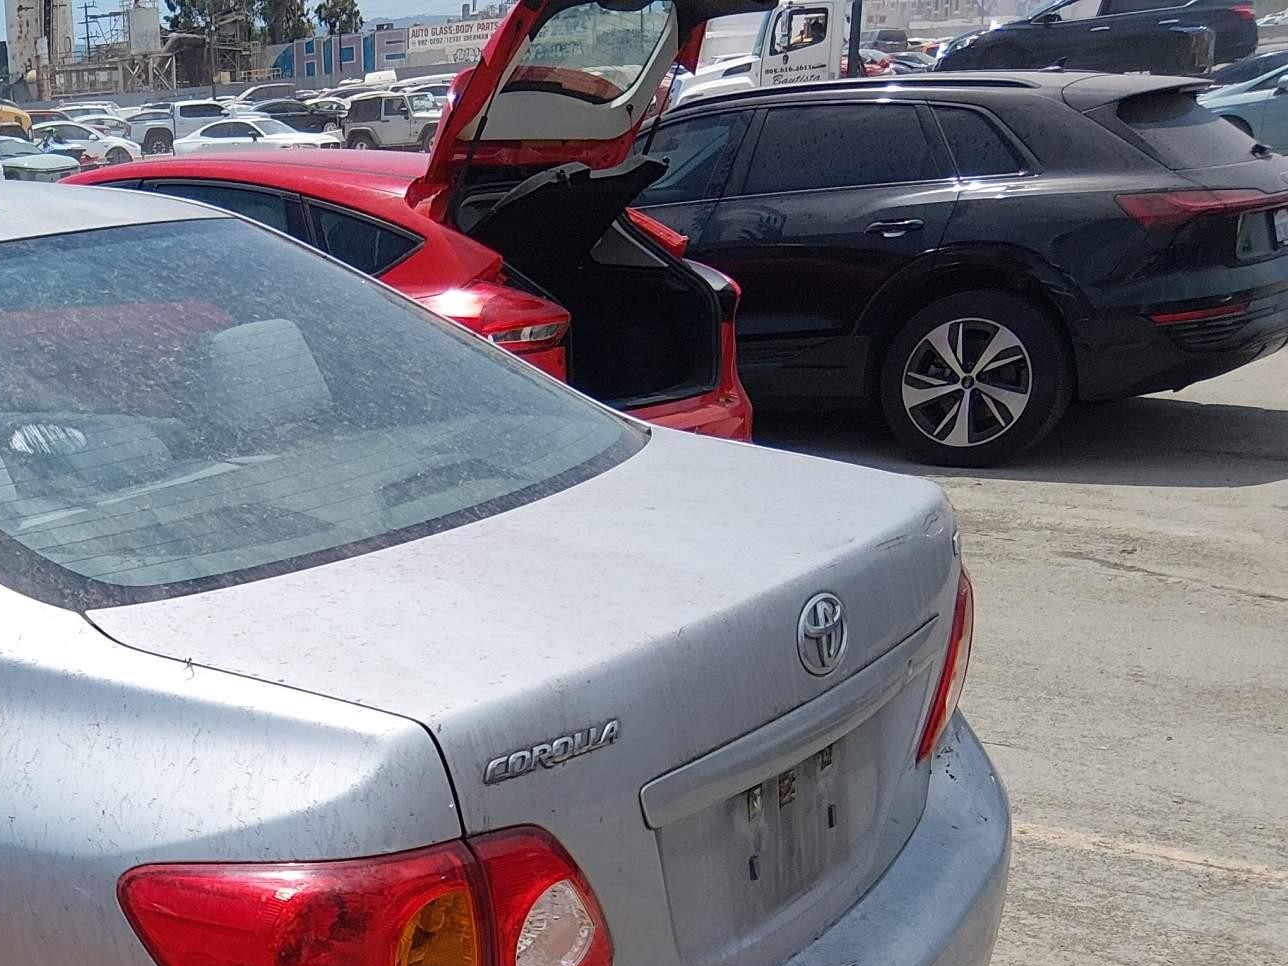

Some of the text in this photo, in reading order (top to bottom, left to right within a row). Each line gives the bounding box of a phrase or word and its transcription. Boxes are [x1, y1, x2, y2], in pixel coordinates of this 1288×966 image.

[411, 28, 428, 38] AUTO
[477, 21, 498, 32] PARTS
[772, 74, 821, 85] Bautista
[483, 719, 618, 785] COROLLA
